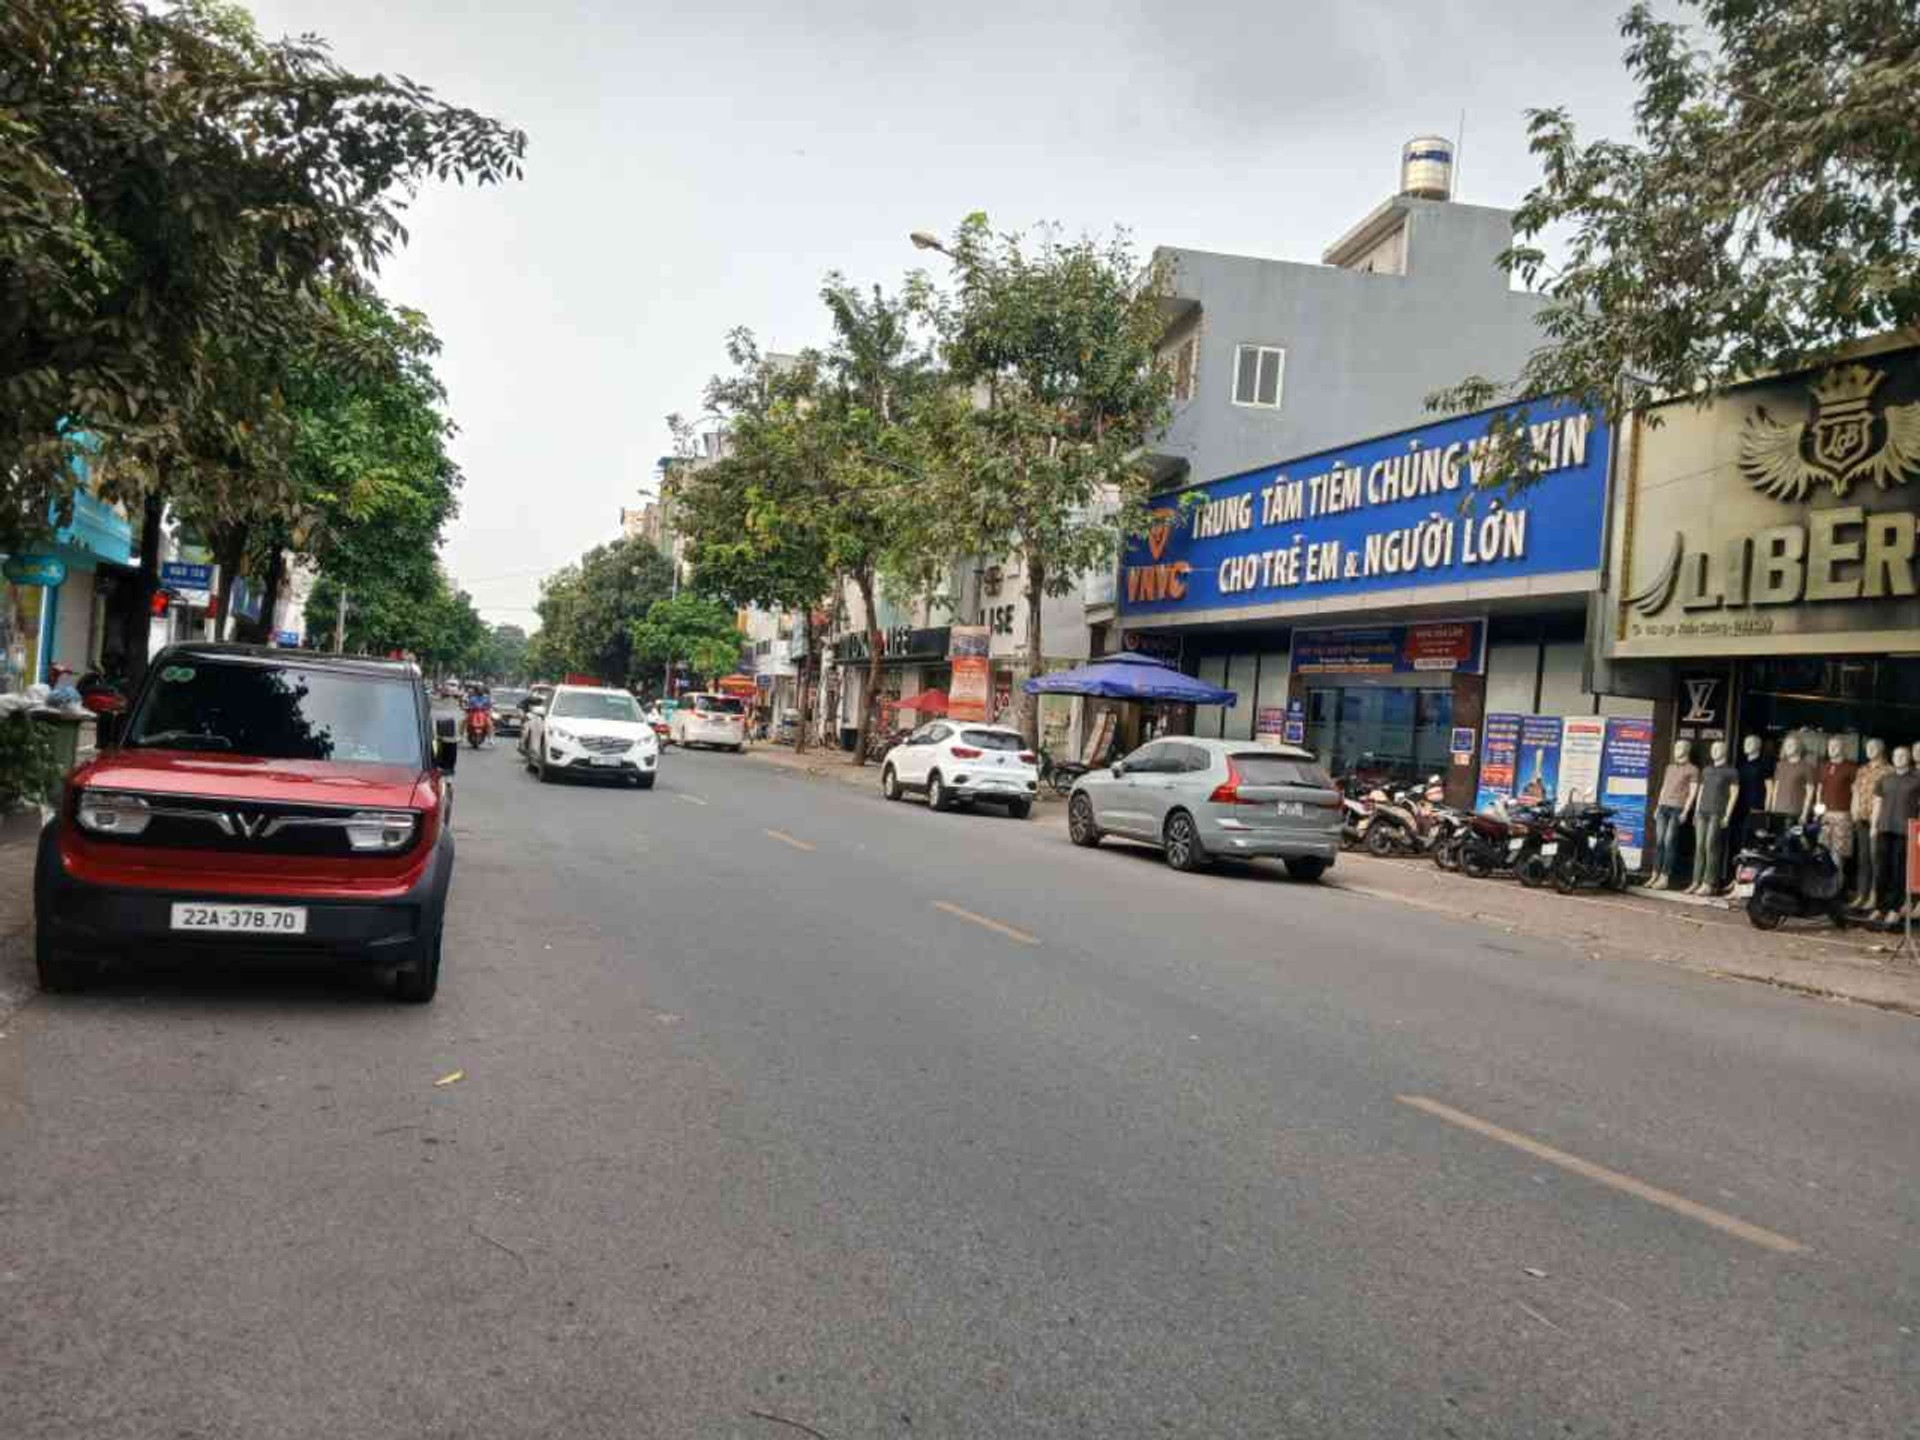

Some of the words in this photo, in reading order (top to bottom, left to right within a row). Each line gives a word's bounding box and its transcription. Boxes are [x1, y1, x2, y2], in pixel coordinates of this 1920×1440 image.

[1192, 492, 1252, 539] TRUNG
[1261, 475, 1303, 525] TÂM
[1309, 456, 1362, 516] TIÊM
[1367, 438, 1461, 504] CHỦNG
[1127, 560, 1192, 602] VNVC
[1218, 554, 1261, 592] CHO
[1261, 533, 1301, 587] TRẺ
[1306, 540, 1340, 581] EM
[1344, 551, 1360, 578] &
[1364, 512, 1453, 576] NGƯỜI
[1462, 501, 1526, 563] LỚN
[1680, 506, 1920, 610] LIBER
[182, 908, 296, 930] 22A-378.70
